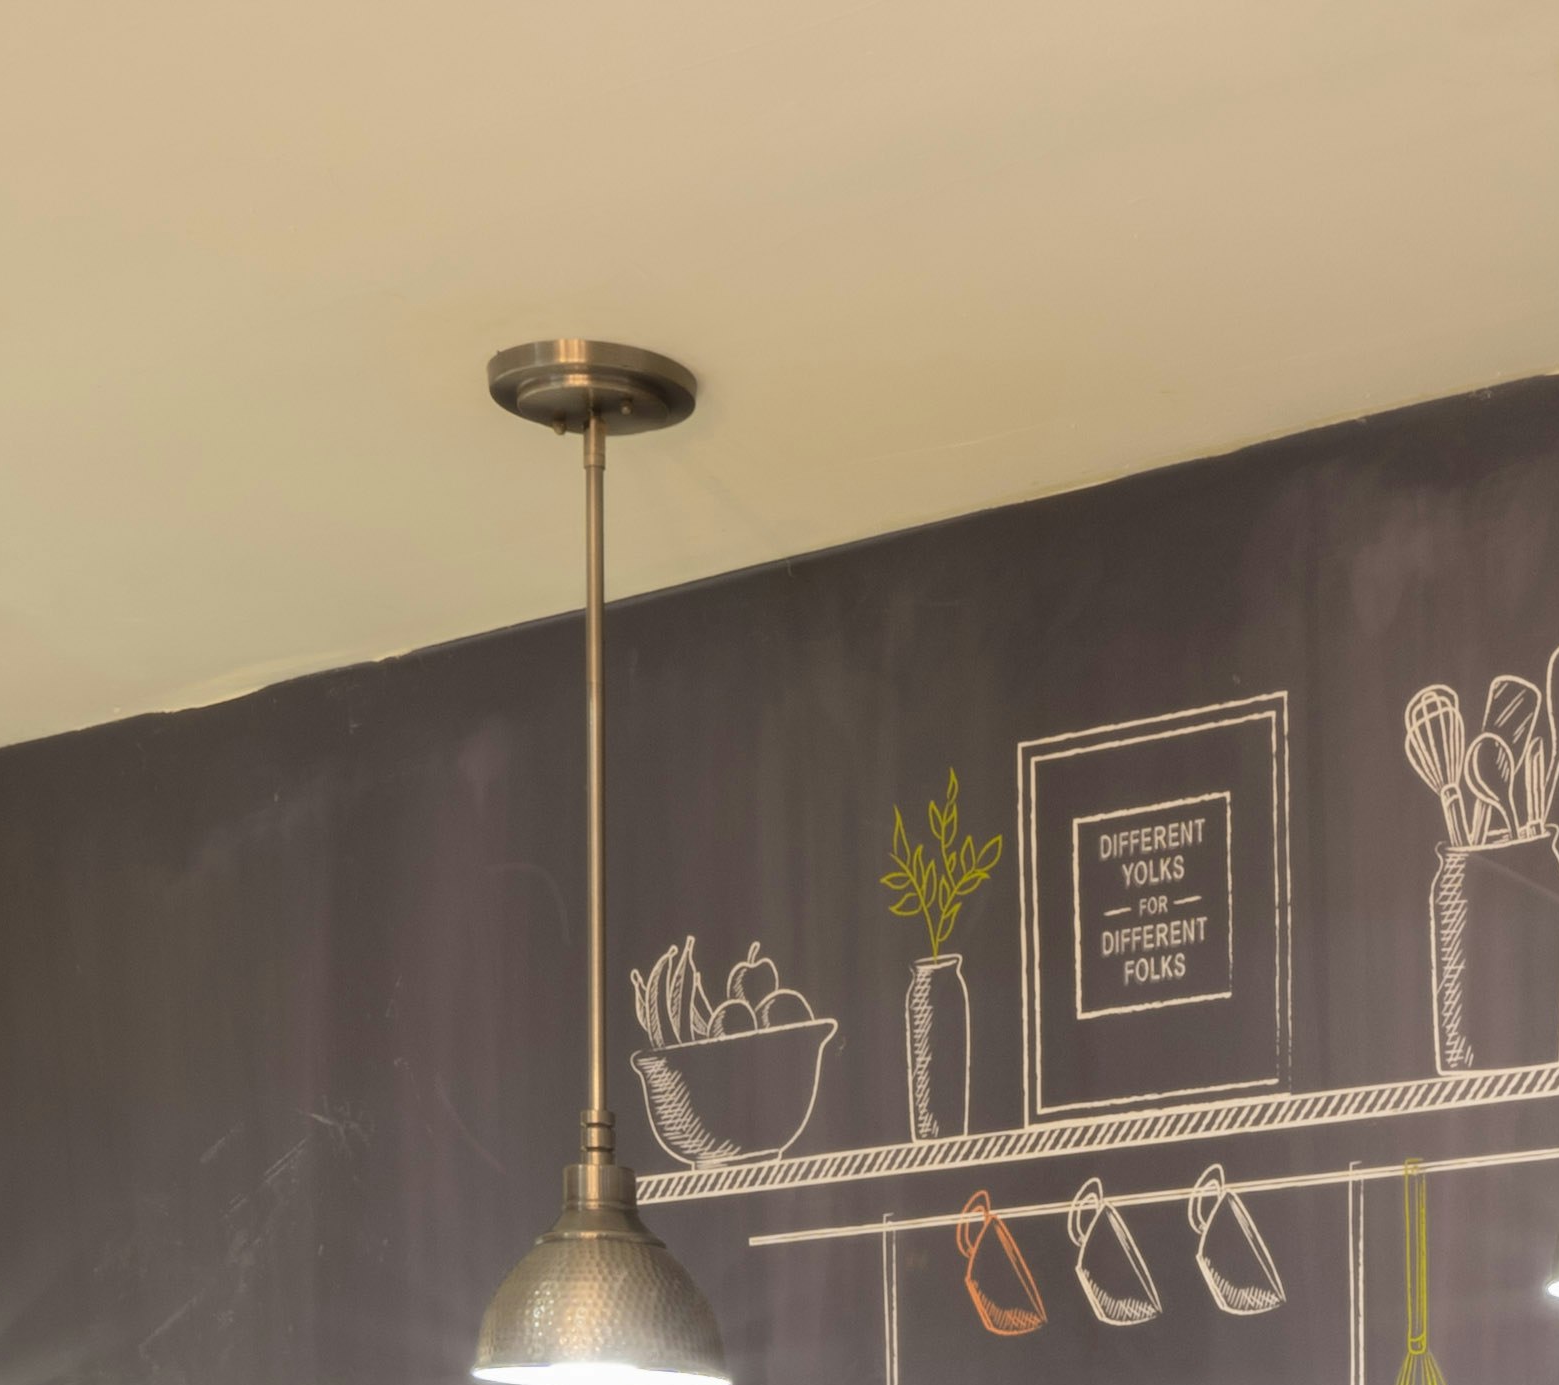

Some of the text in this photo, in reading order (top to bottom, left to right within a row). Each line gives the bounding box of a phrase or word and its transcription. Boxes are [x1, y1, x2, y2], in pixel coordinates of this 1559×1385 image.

[1099, 818, 1206, 860] DIFFERENT
[1122, 855, 1185, 888] YOLKS
[1139, 895, 1168, 915] FOR
[1102, 916, 1207, 956] DIFFERENT
[1124, 953, 1186, 985] FOLKS
